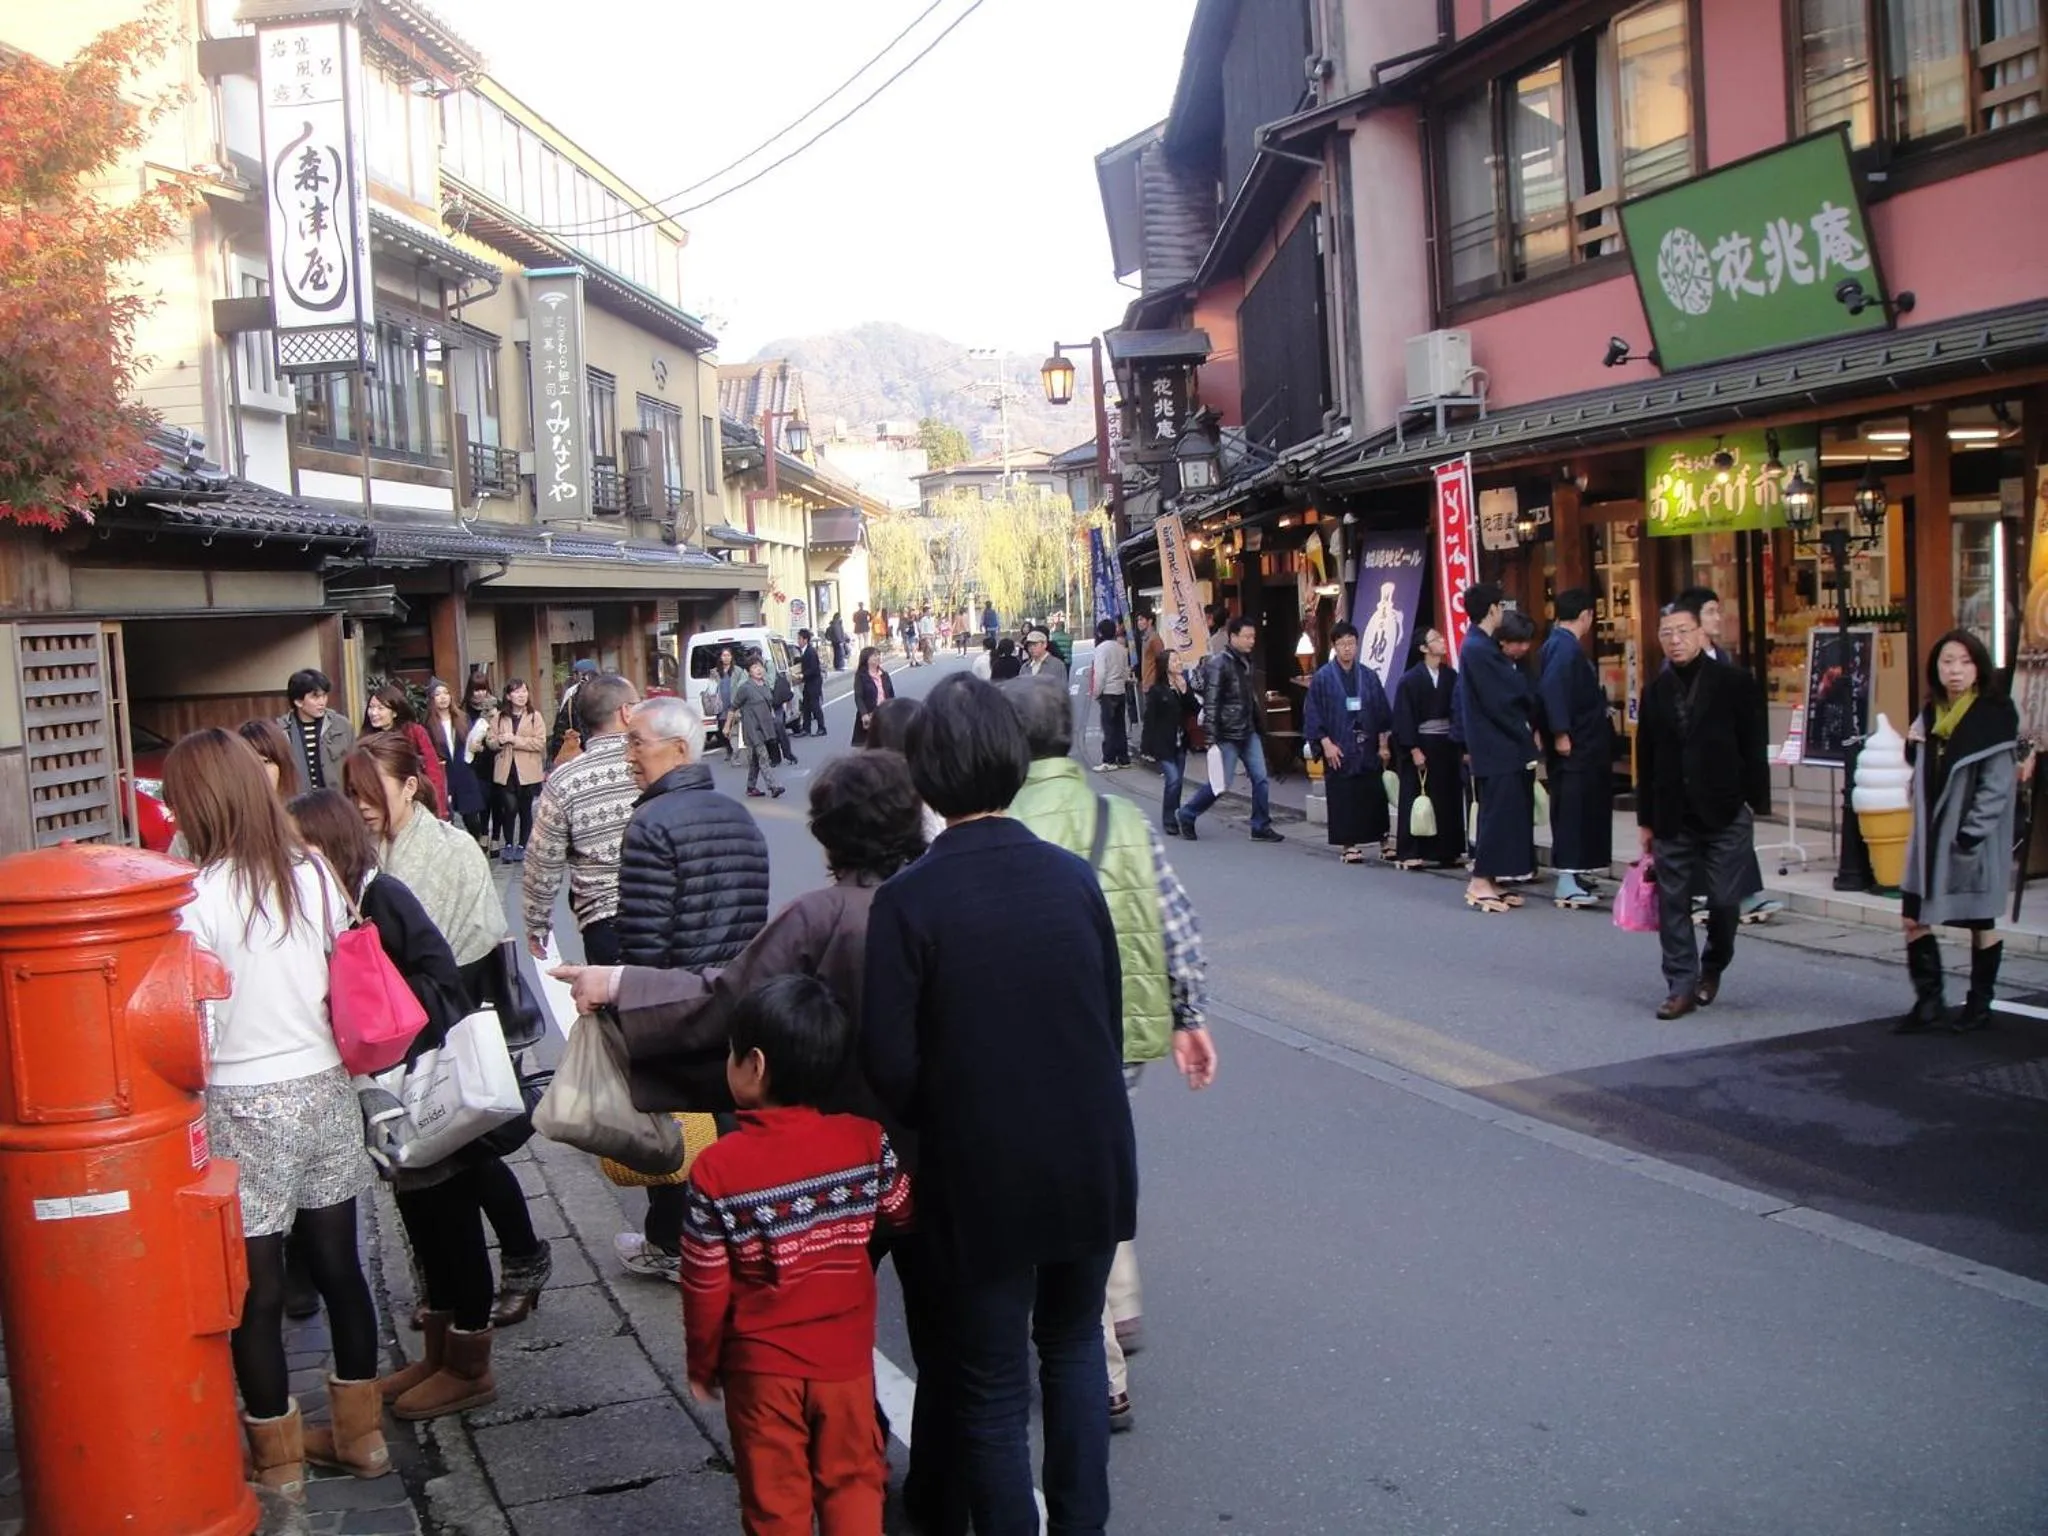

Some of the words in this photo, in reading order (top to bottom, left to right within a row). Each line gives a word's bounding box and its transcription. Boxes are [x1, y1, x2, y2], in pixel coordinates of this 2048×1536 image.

[294, 145, 334, 292] 森津屋
[1710, 200, 1872, 303] 花兆庵
[545, 399, 578, 503] みなとや
[1152, 377, 1177, 440] 花兆庵
